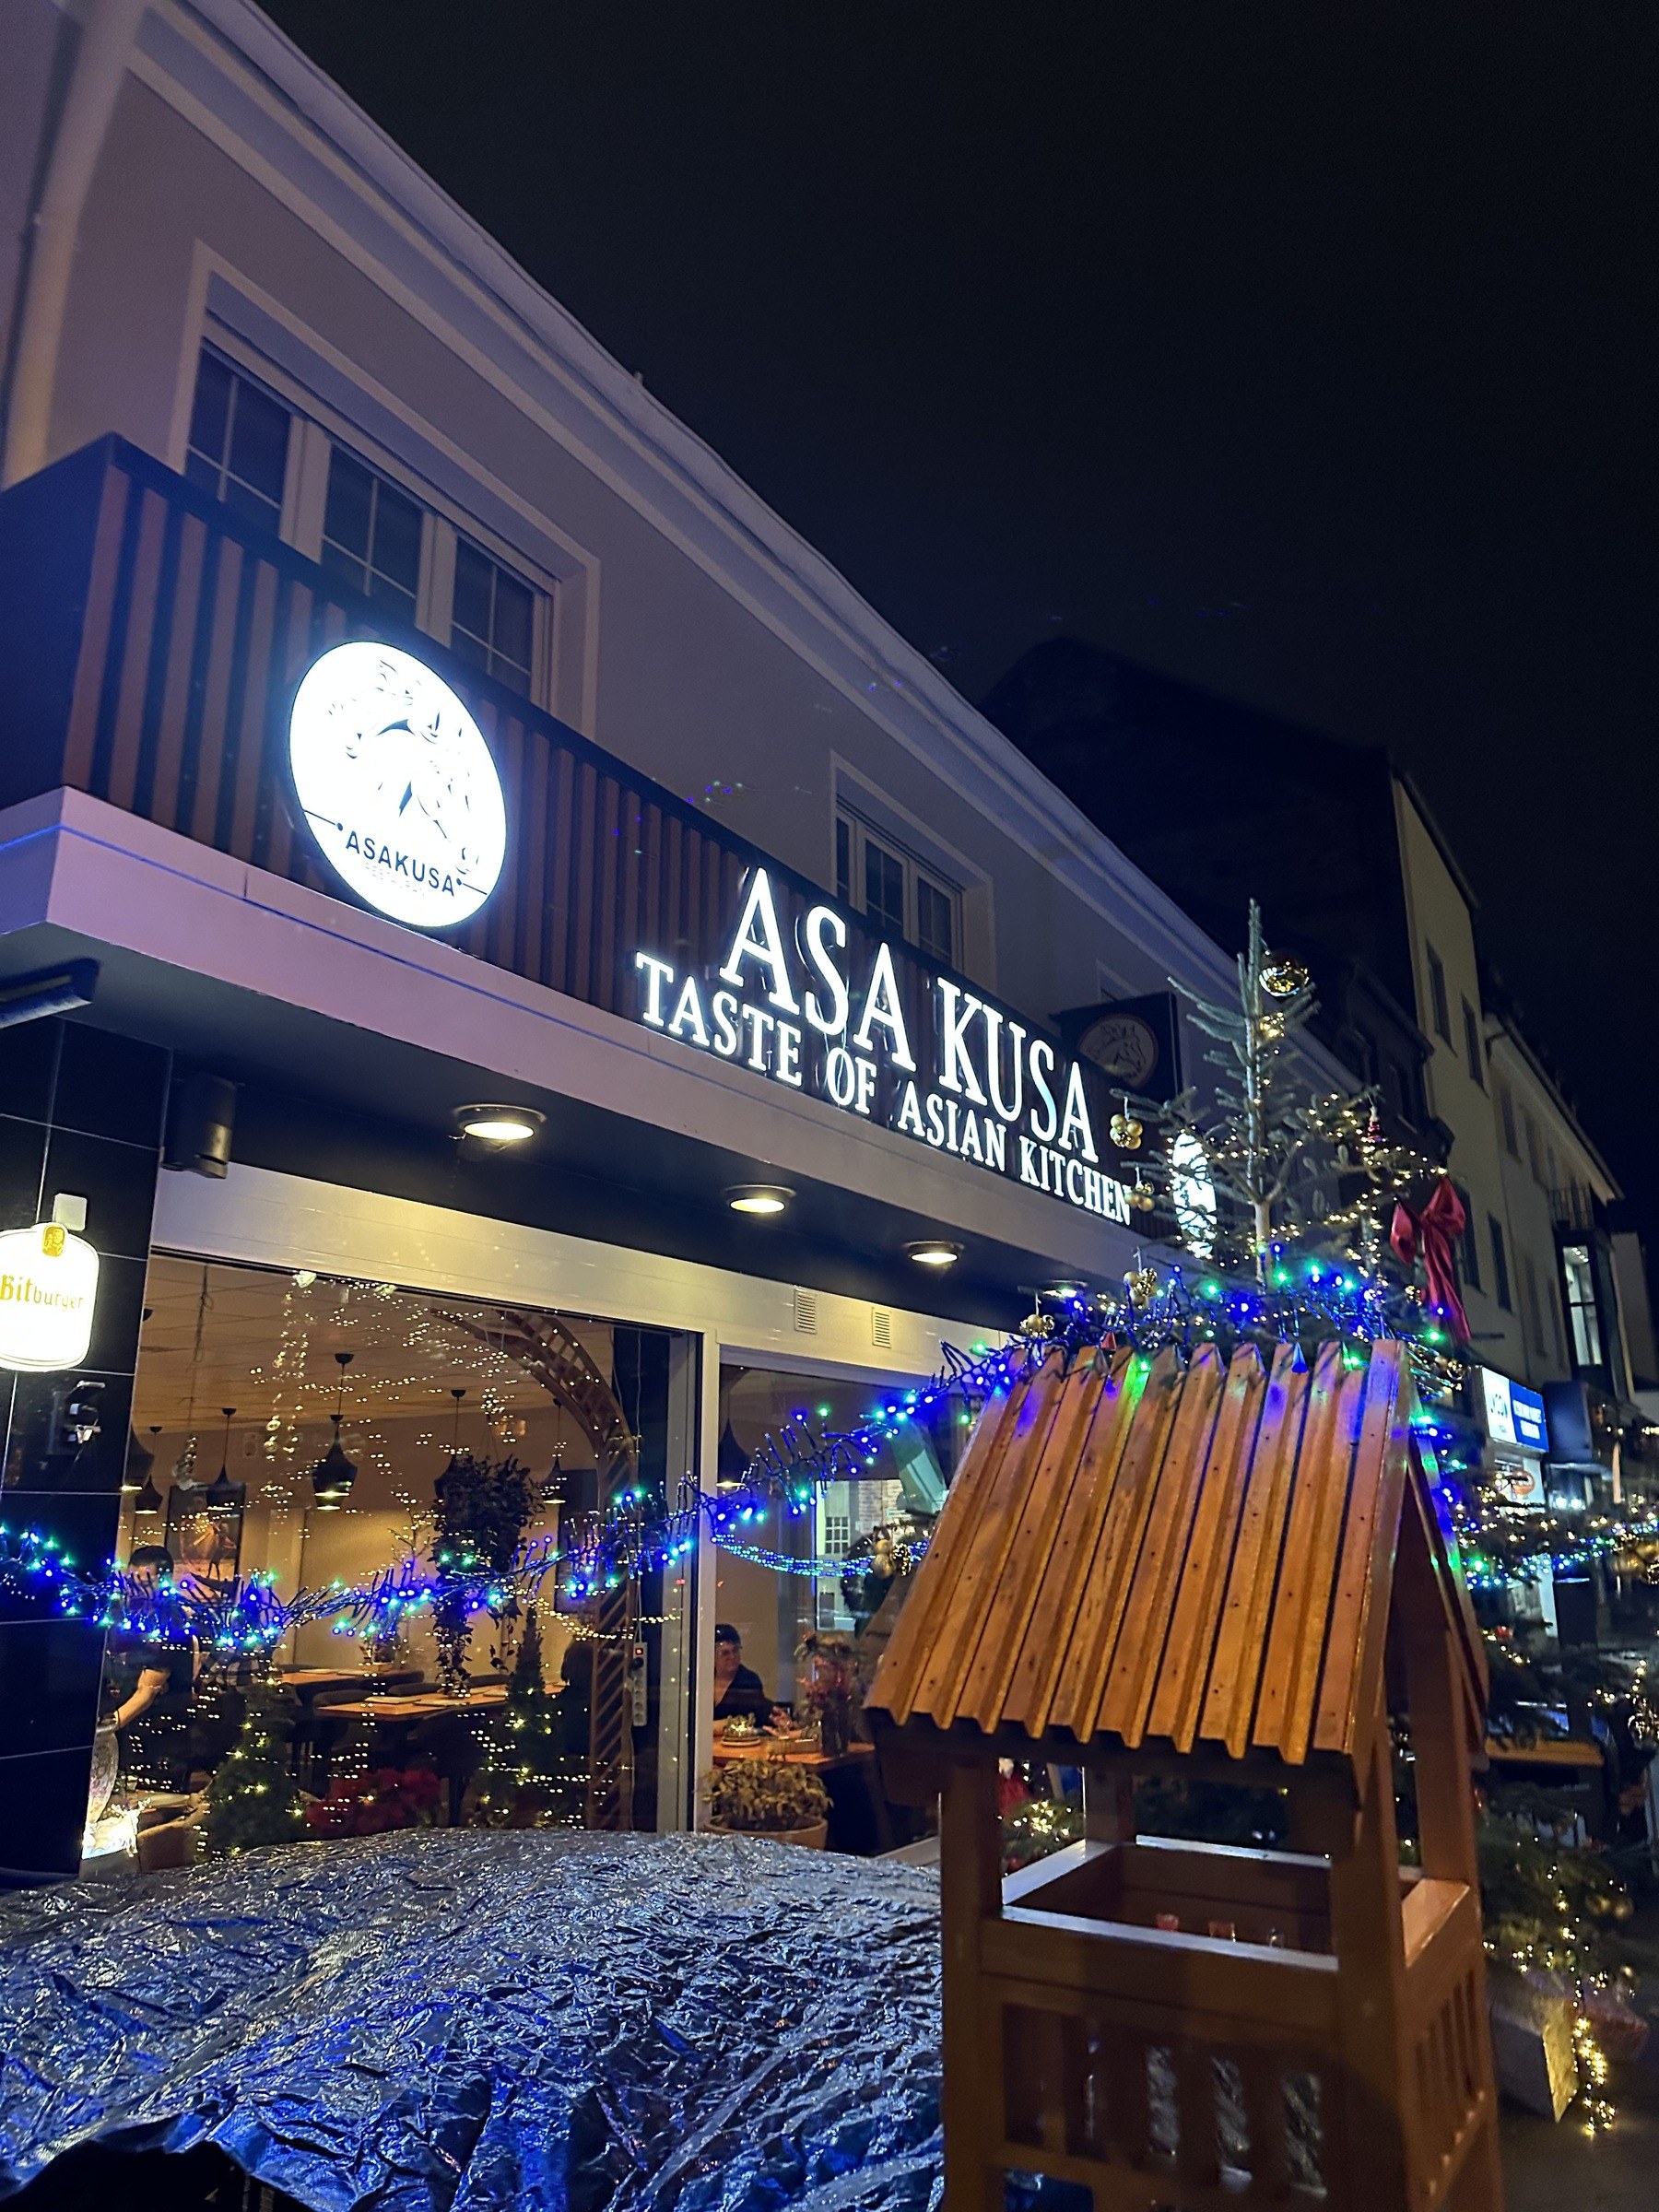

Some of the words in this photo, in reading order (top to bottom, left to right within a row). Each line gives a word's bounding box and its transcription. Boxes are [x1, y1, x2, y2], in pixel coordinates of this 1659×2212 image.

[346, 830, 454, 897] ASAKUSA
[636, 951, 802, 1087] TASTE
[826, 1046, 877, 1114] OF
[897, 1080, 1007, 1171] ASIAN
[1018, 1134, 1132, 1227] KITCHEN
[720, 867, 916, 1072] ASA
[937, 976, 1099, 1163] KUSA
[0, 1274, 83, 1312] Bitburger
